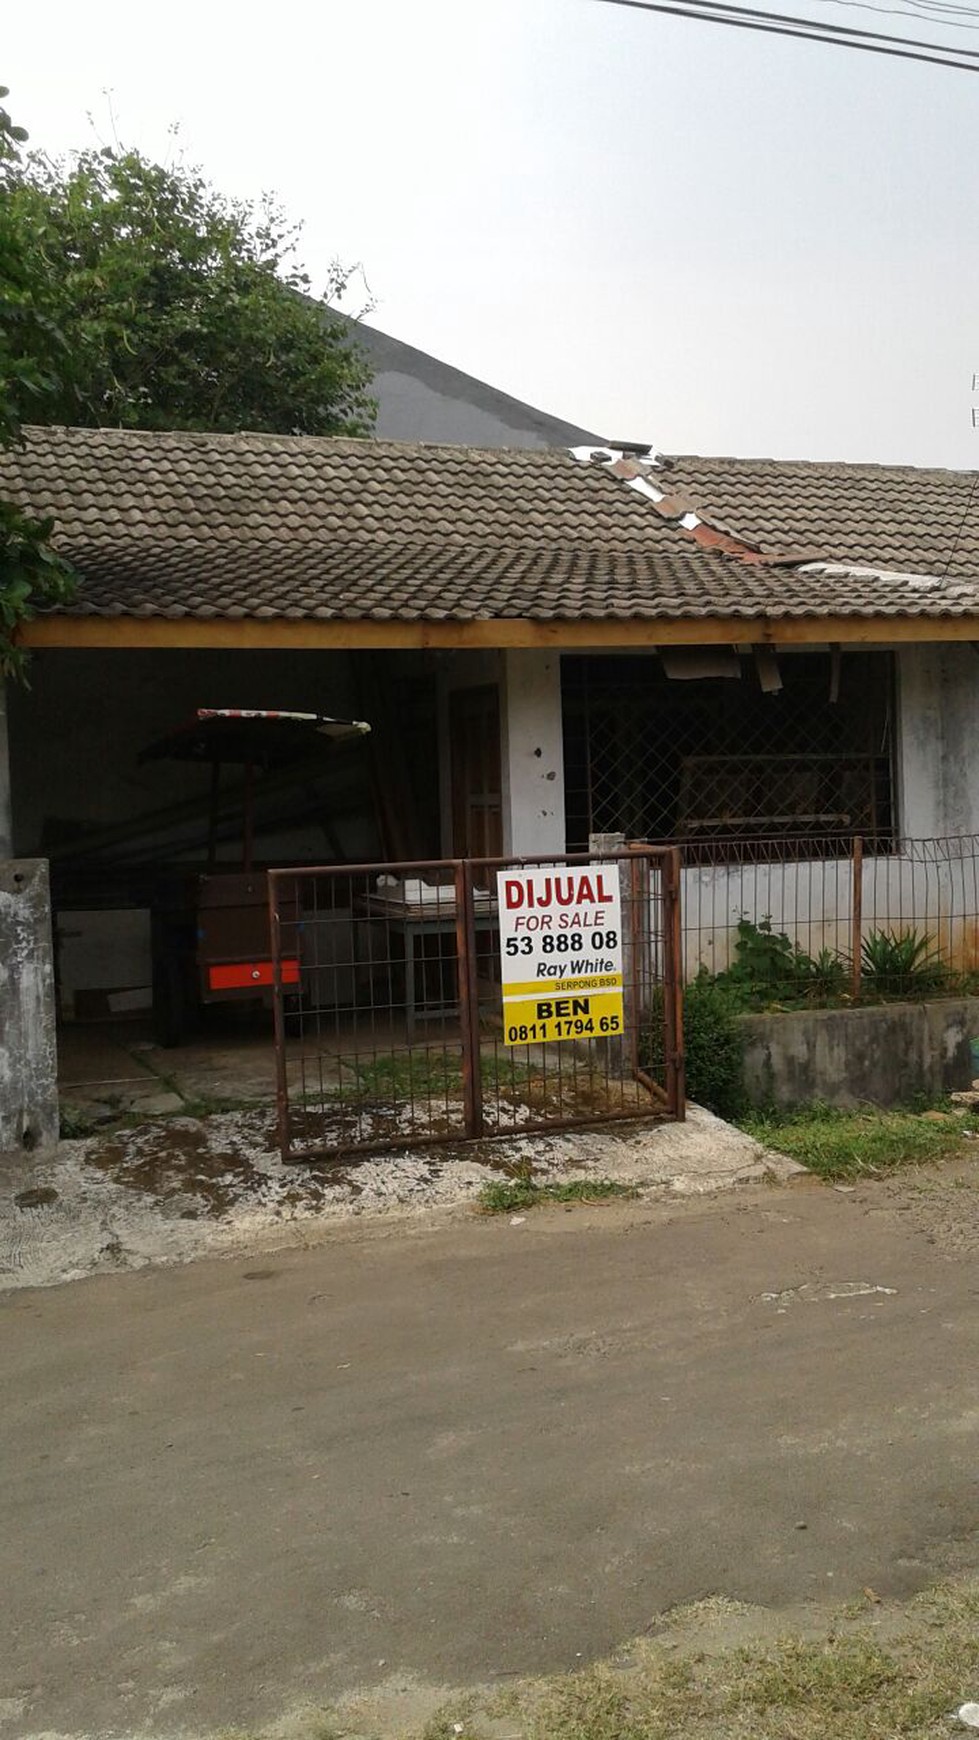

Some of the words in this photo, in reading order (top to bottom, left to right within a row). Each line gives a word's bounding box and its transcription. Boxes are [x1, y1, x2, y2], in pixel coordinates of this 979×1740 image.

[505, 875, 613, 910] DIJUAL
[515, 914, 553, 932] FOR
[558, 910, 605, 929] SALE
[505, 936, 533, 956] 53
[542, 933, 583, 953] 888
[591, 931, 618, 950] 08
[536, 962, 567, 979] Ray
[555, 979, 598, 991] SERPONG
[599, 977, 617, 988] BSD
[537, 998, 590, 1020] BEN
[508, 1023, 547, 1042] 0811
[555, 1018, 594, 1036] 1794
[599, 1015, 620, 1032] 65
